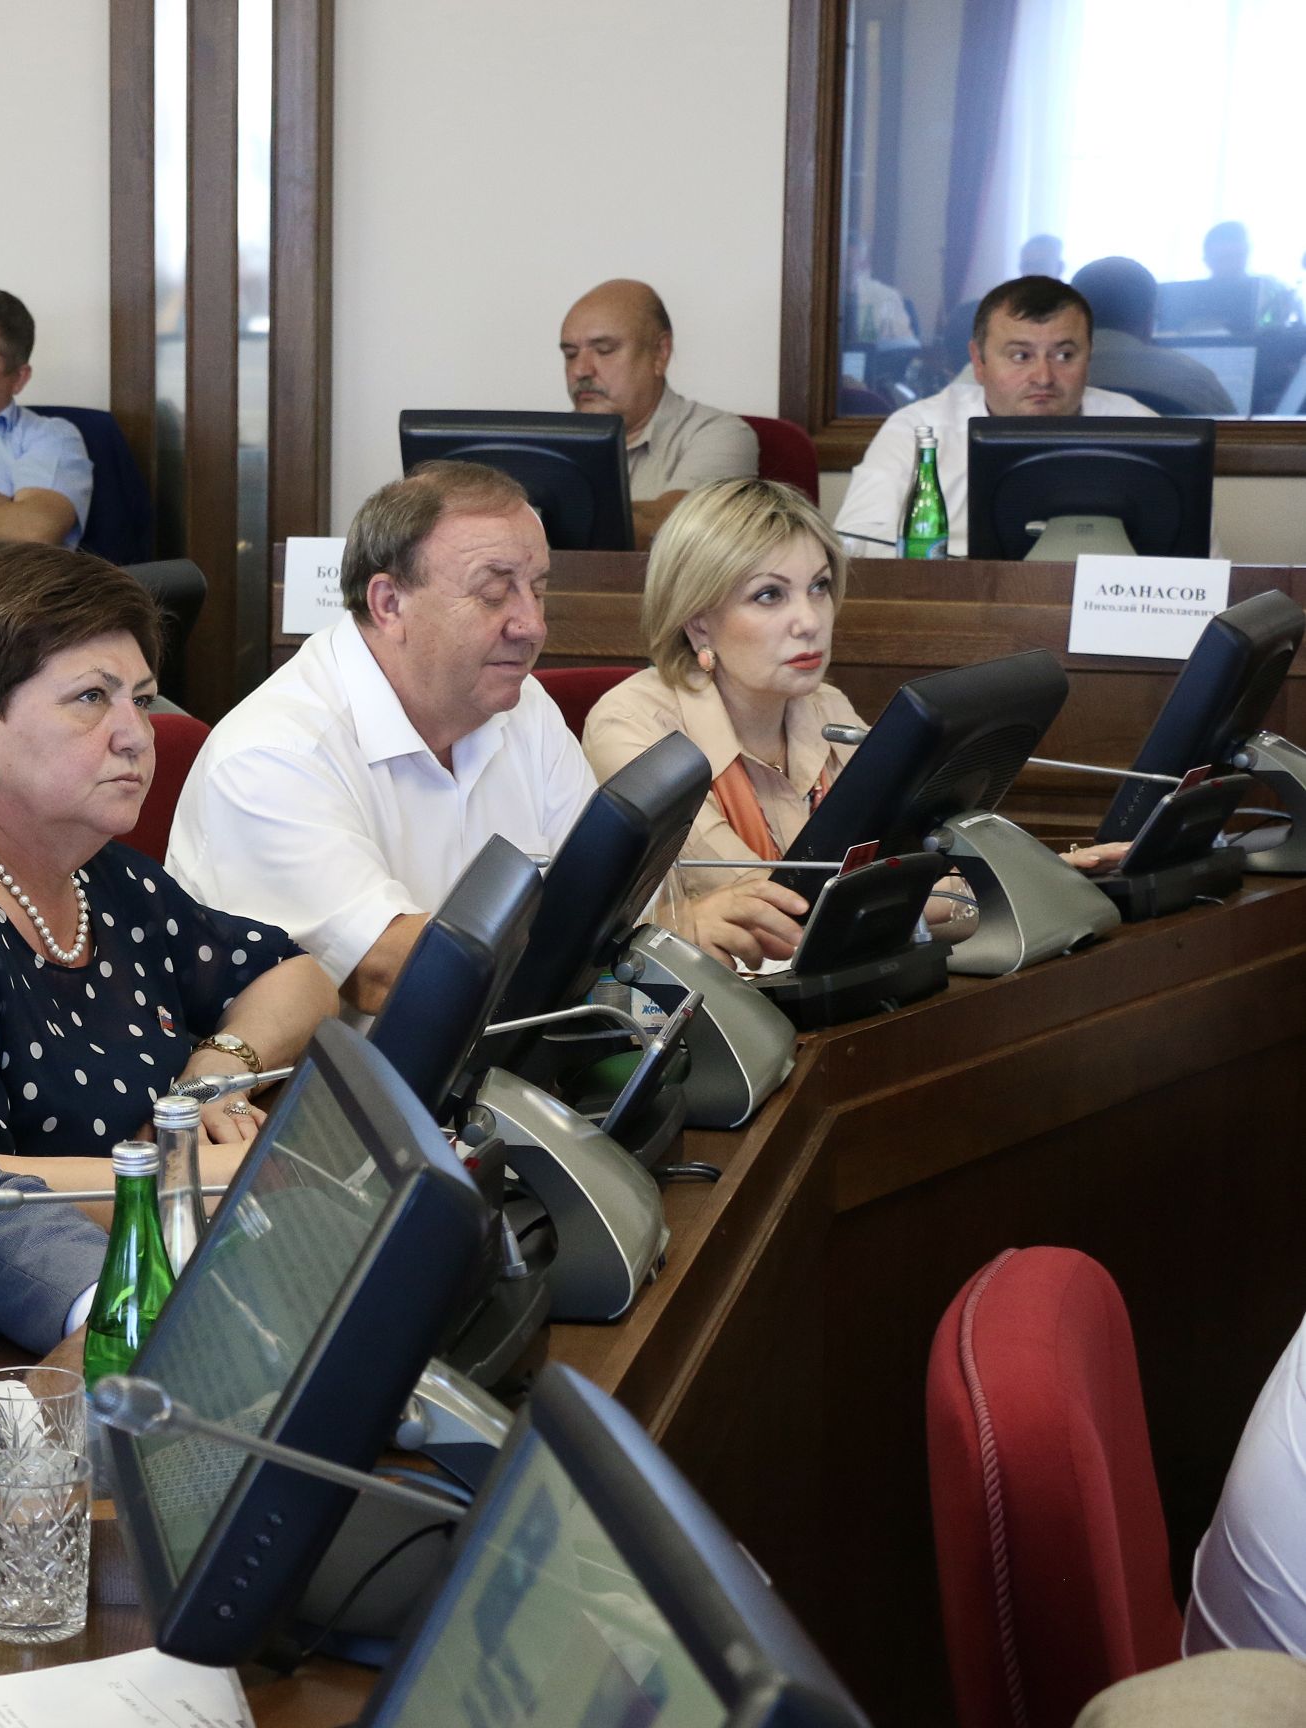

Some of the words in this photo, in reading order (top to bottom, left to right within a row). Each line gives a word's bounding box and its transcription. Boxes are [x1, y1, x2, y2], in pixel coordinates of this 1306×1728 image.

[317, 566, 341, 579] БО
[1095, 584, 1207, 601] АФАНАСОВ
[1083, 600, 1137, 612] Николай
[1141, 604, 1216, 617] Николаевич
